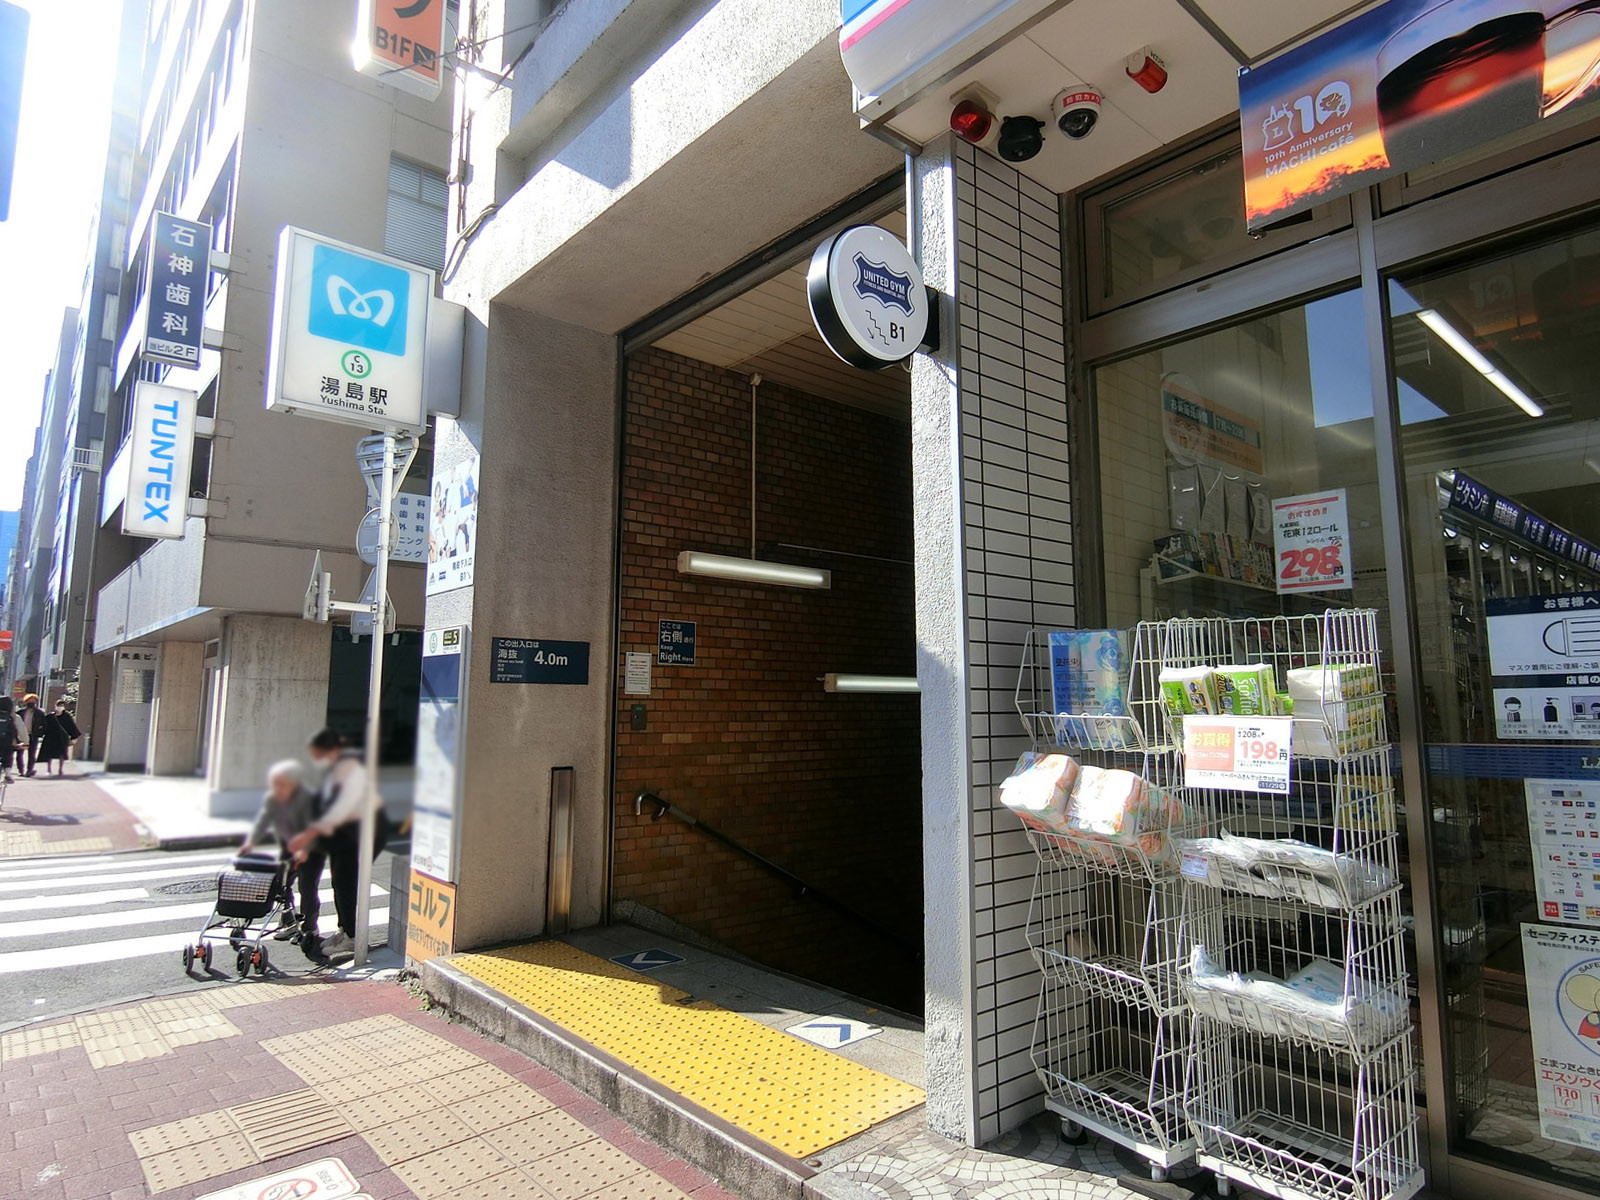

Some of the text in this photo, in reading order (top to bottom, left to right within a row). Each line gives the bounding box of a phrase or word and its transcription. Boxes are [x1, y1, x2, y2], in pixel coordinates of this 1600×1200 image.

[376, 26, 411, 58] B1F
[1294, 81, 1351, 134] 10
[1265, 122, 1352, 164] 10th Anniversary
[1266, 133, 1355, 178] MACHI café
[162, 223, 196, 336] 石神歯科
[863, 269, 906, 295] UNITED GYM
[890, 322, 905, 342] B1
[350, 363, 364, 374] 13
[354, 355, 360, 363] C
[320, 376, 388, 406] 湯島駅
[320, 394, 387, 416] Yushima Sta.
[143, 400, 179, 523] TUNTEX
[1280, 546, 1342, 579] 298
[1334, 565, 1344, 576] 円
[1544, 596, 1599, 609] お客様へ
[498, 640, 540, 648] この出入口は
[661, 630, 682, 643] 右側
[498, 648, 568, 666] 海抜 4.0m
[660, 652, 681, 662] Right
[1190, 732, 1230, 747] お買得
[1240, 740, 1278, 760] 198
[1280, 752, 1288, 760] 円
[411, 880, 450, 928] ゴルフ
[1528, 928, 1600, 946] セーフティステ
[1541, 1069, 1600, 1091] エスゾウく
[1556, 1086, 1579, 1100] 110
